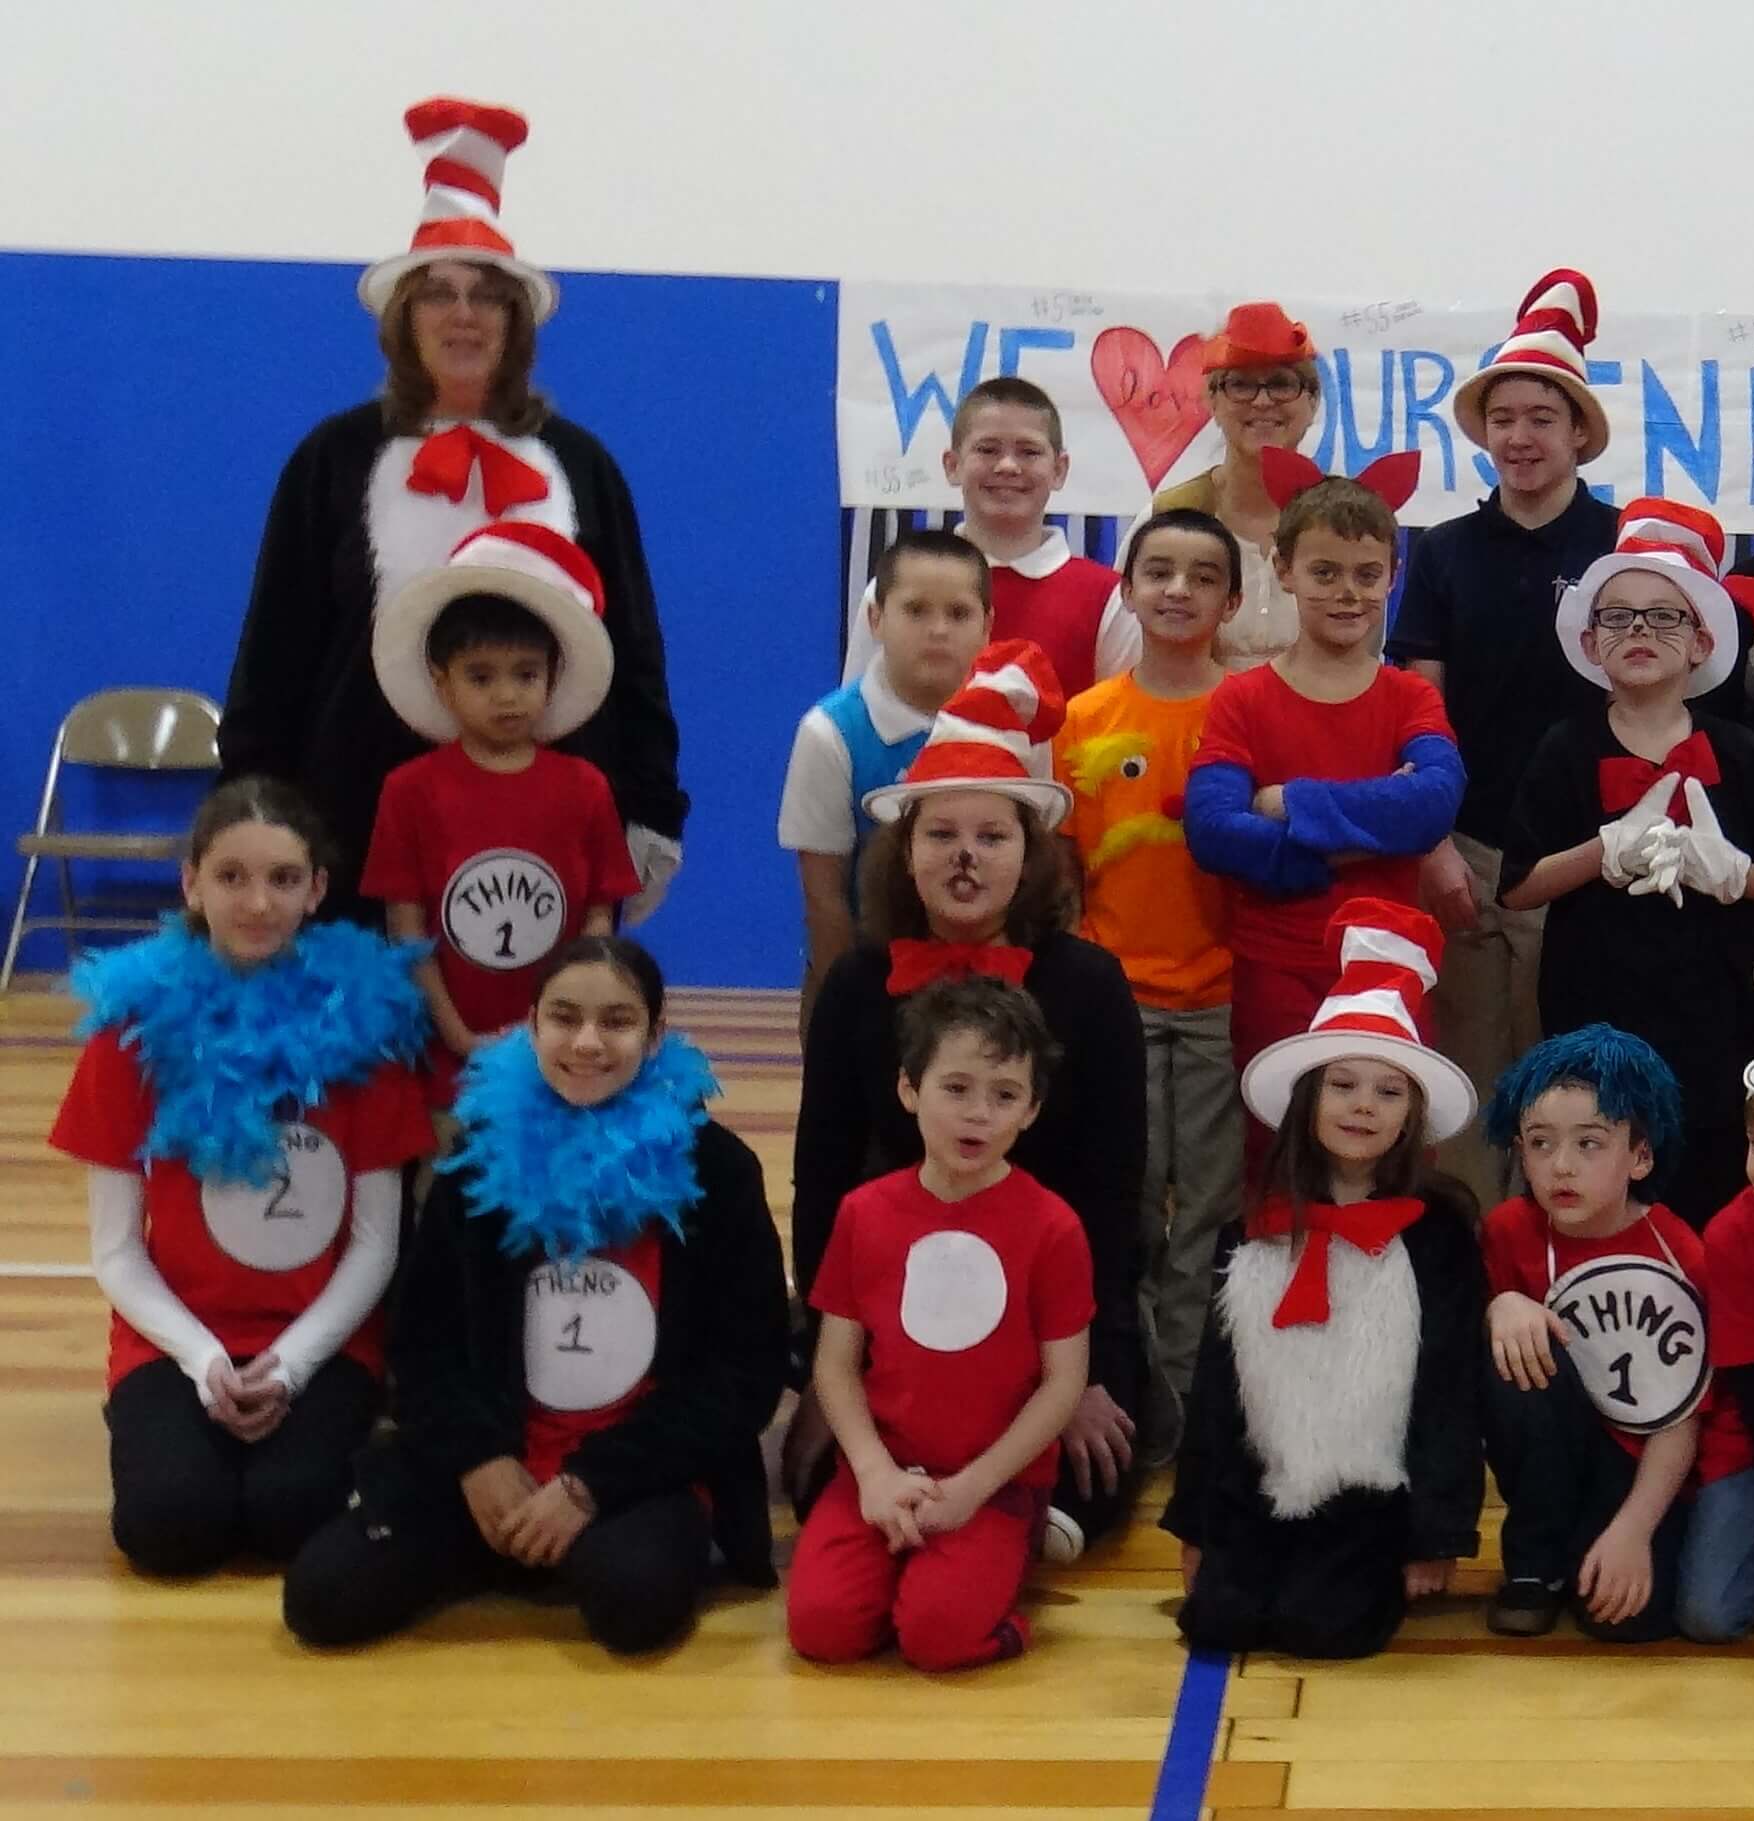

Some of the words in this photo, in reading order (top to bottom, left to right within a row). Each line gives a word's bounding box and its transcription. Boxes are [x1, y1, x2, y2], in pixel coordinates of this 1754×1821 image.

[456, 870, 556, 919] THING
[494, 920, 517, 960] 1
[263, 1156, 305, 1221] 2
[555, 1312, 594, 1355] 1
[1557, 1290, 1696, 1367] THING
[1607, 1352, 1639, 1407] 1
